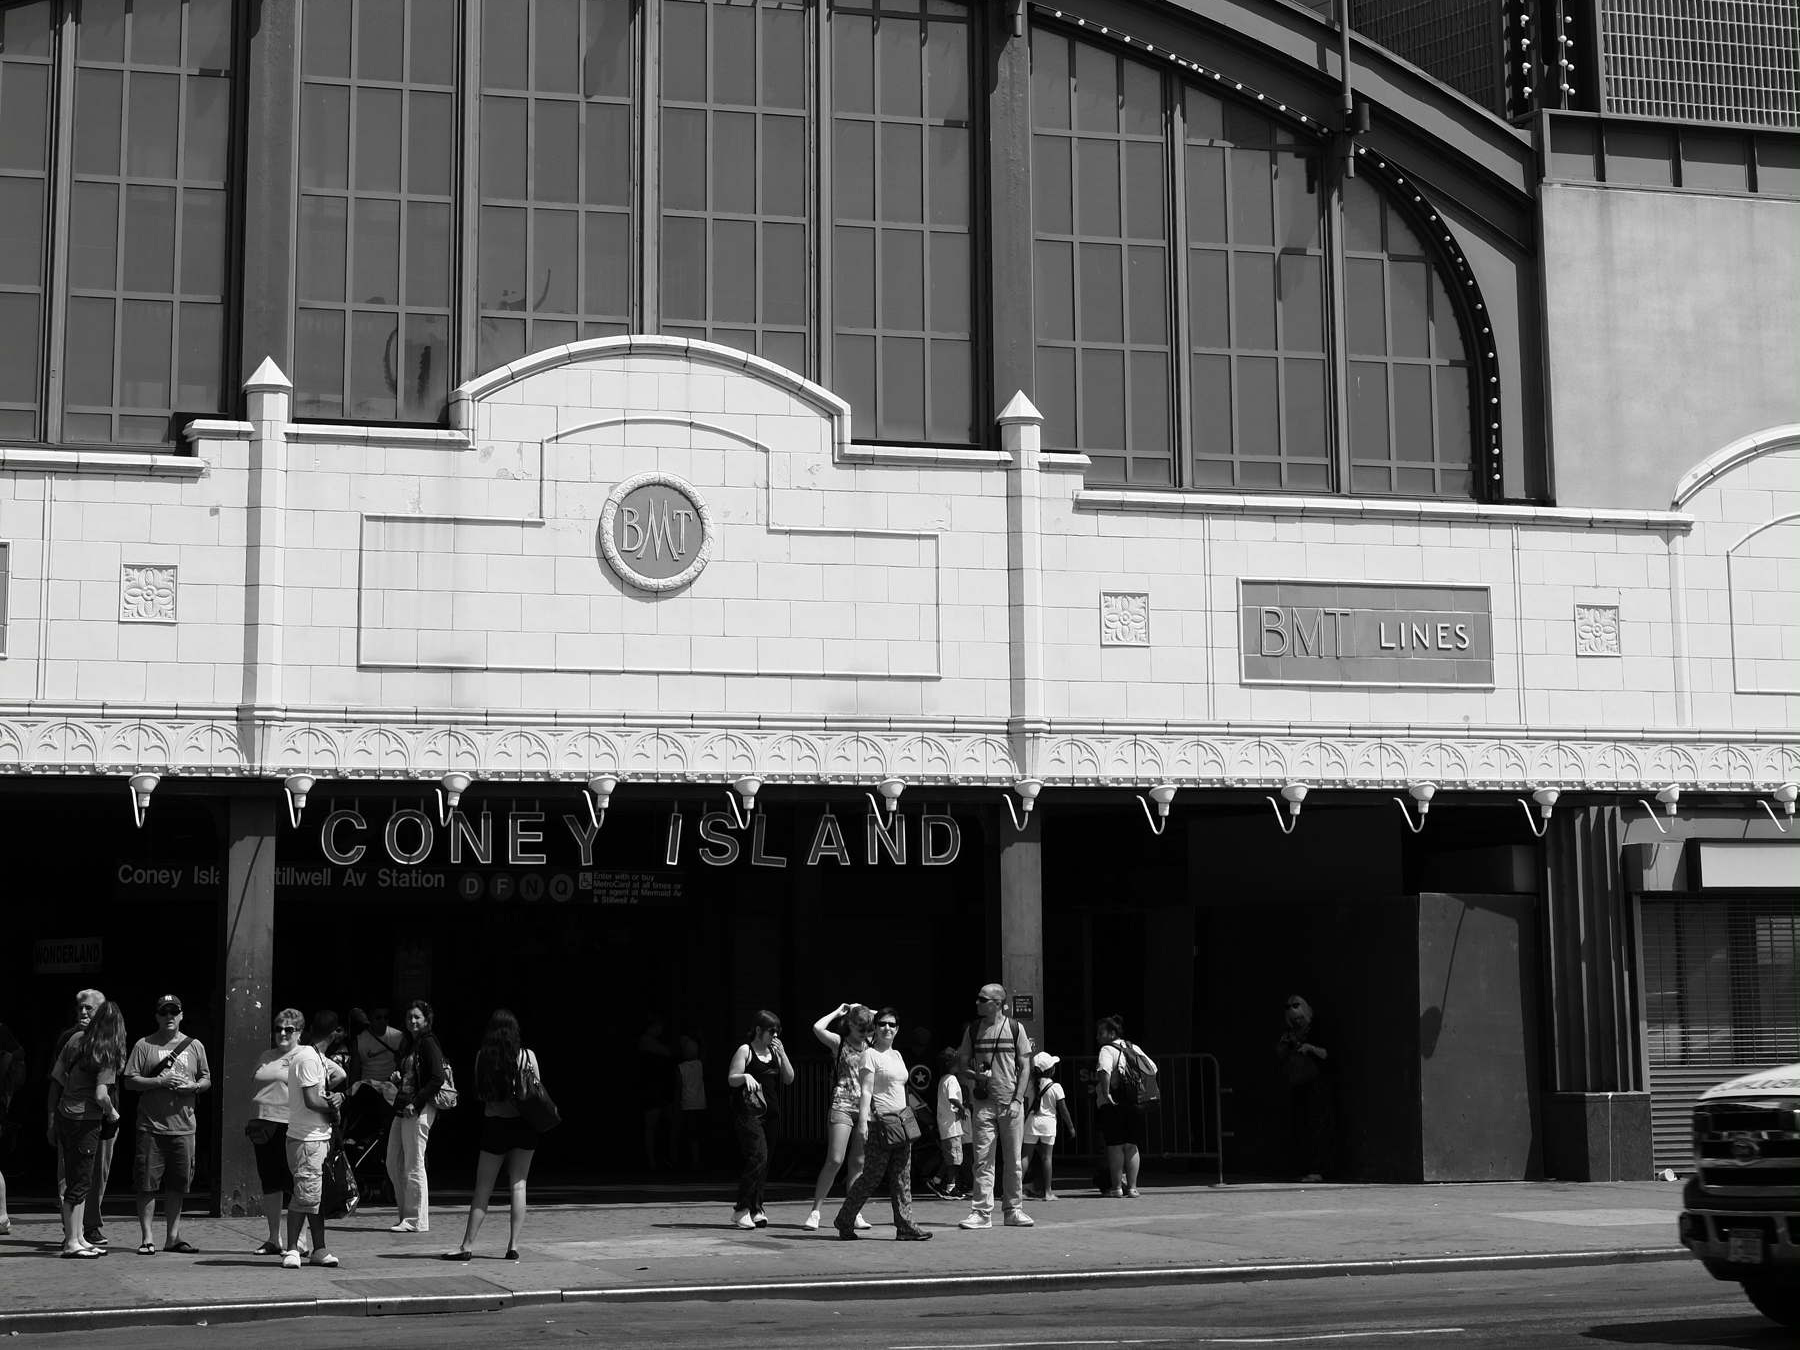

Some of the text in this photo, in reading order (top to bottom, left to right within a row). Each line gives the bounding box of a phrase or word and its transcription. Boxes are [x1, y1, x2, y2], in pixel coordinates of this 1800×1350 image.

[621, 498, 693, 561] BMT
[1260, 606, 1471, 659] BMT LINES
[321, 809, 961, 867] CONEY ISLAND
[117, 864, 182, 888] Coney
[274, 866, 332, 888] tillwell
[342, 868, 367, 887] Av
[377, 868, 445, 888] Station
[465, 877, 479, 894] D
[496, 878, 508, 895] F
[525, 879, 538, 895] N
[555, 880, 568, 895] Q
[593, 872, 612, 880] Enter
[615, 873, 629, 881] with
[641, 874, 655, 882] buy
[593, 880, 630, 888] MetroCard
[601, 896, 627, 904] Stillwell
[608, 889, 629, 897] agent
[640, 889, 671, 897] Mermaid
[35, 943, 99, 965] WONDERLAND
